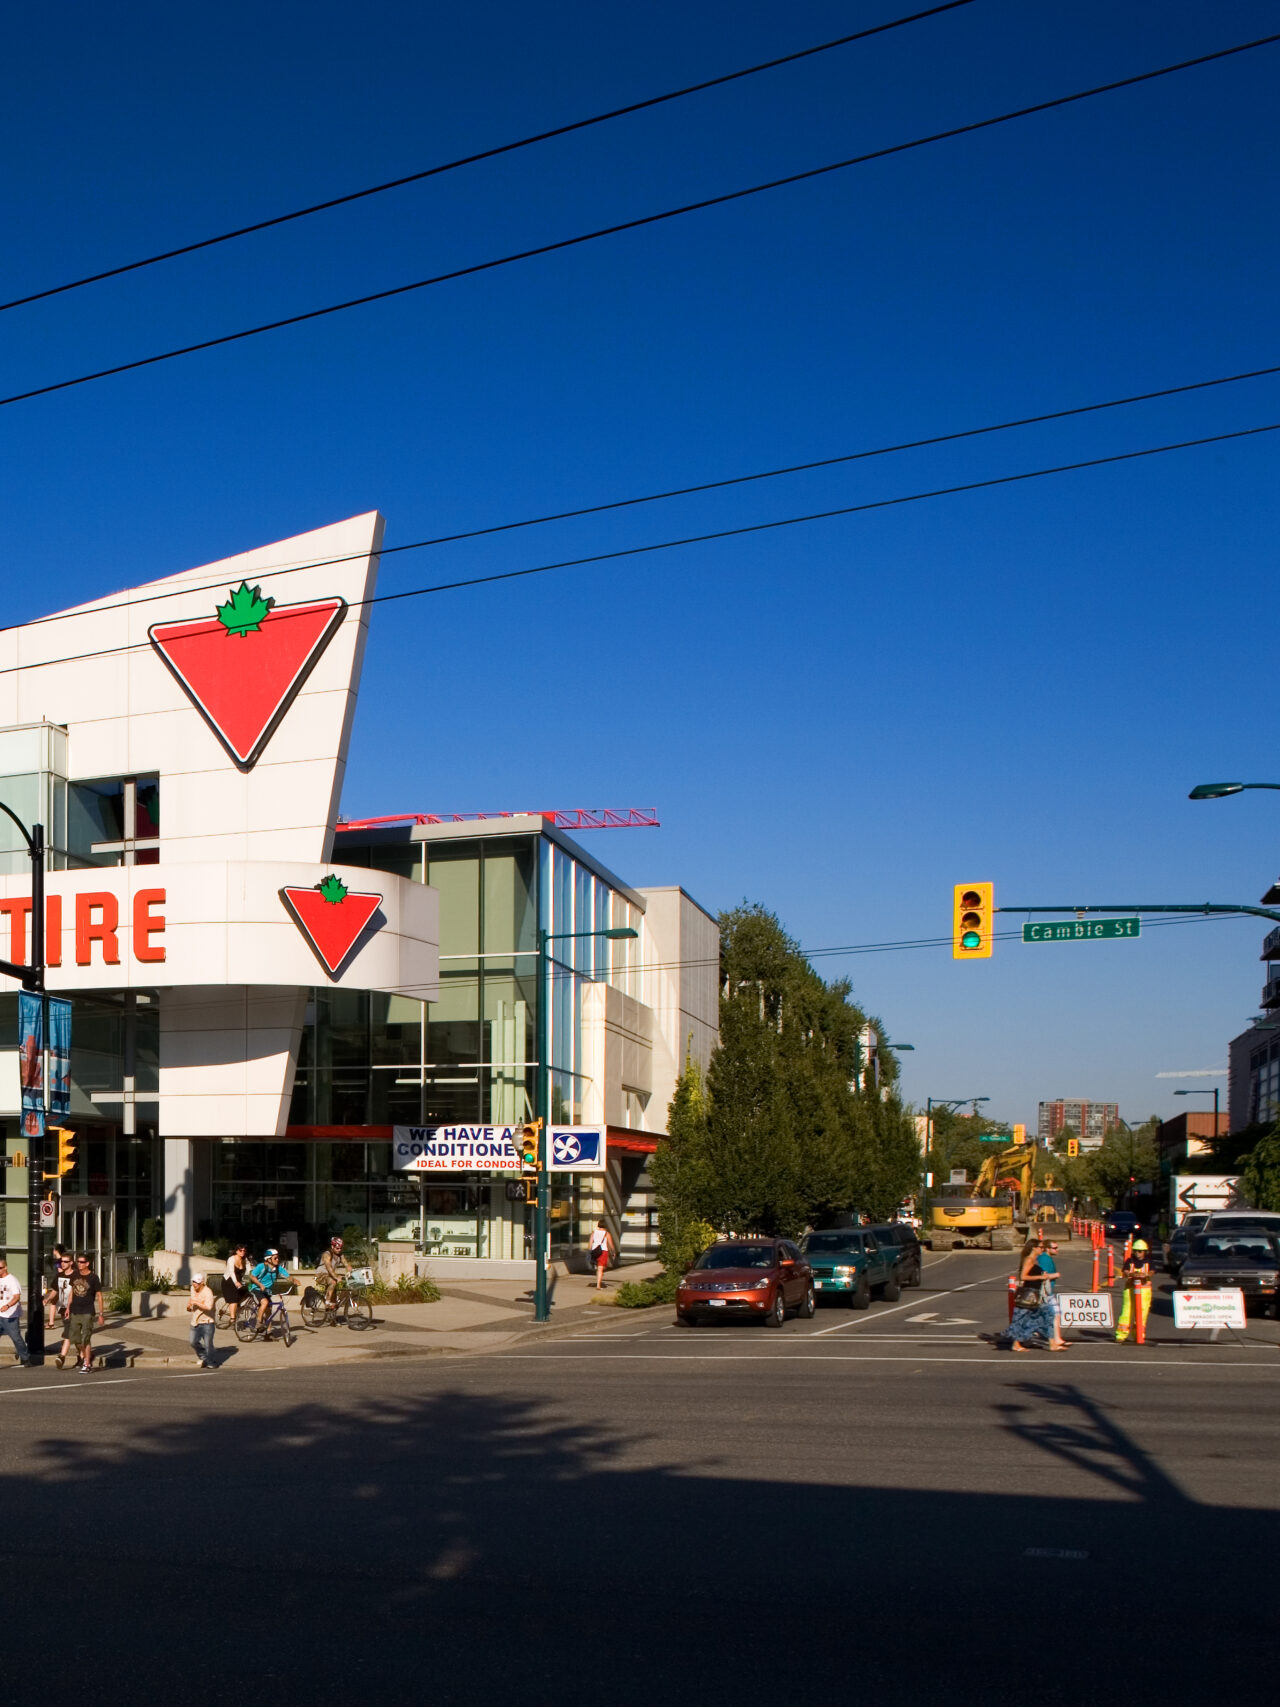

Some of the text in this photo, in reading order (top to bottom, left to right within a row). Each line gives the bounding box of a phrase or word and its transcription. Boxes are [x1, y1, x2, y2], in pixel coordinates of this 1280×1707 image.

[1030, 920, 1133, 940] Cambie St
[409, 1128, 437, 1141] WE
[444, 1127, 494, 1141] HAVE
[397, 1143, 520, 1157] CONDITIONE
[416, 1160, 448, 1168] IDEAL
[451, 1160, 472, 1168] FOR
[1069, 1298, 1100, 1309] ROAD
[1064, 1312, 1108, 1322] CLOSED
